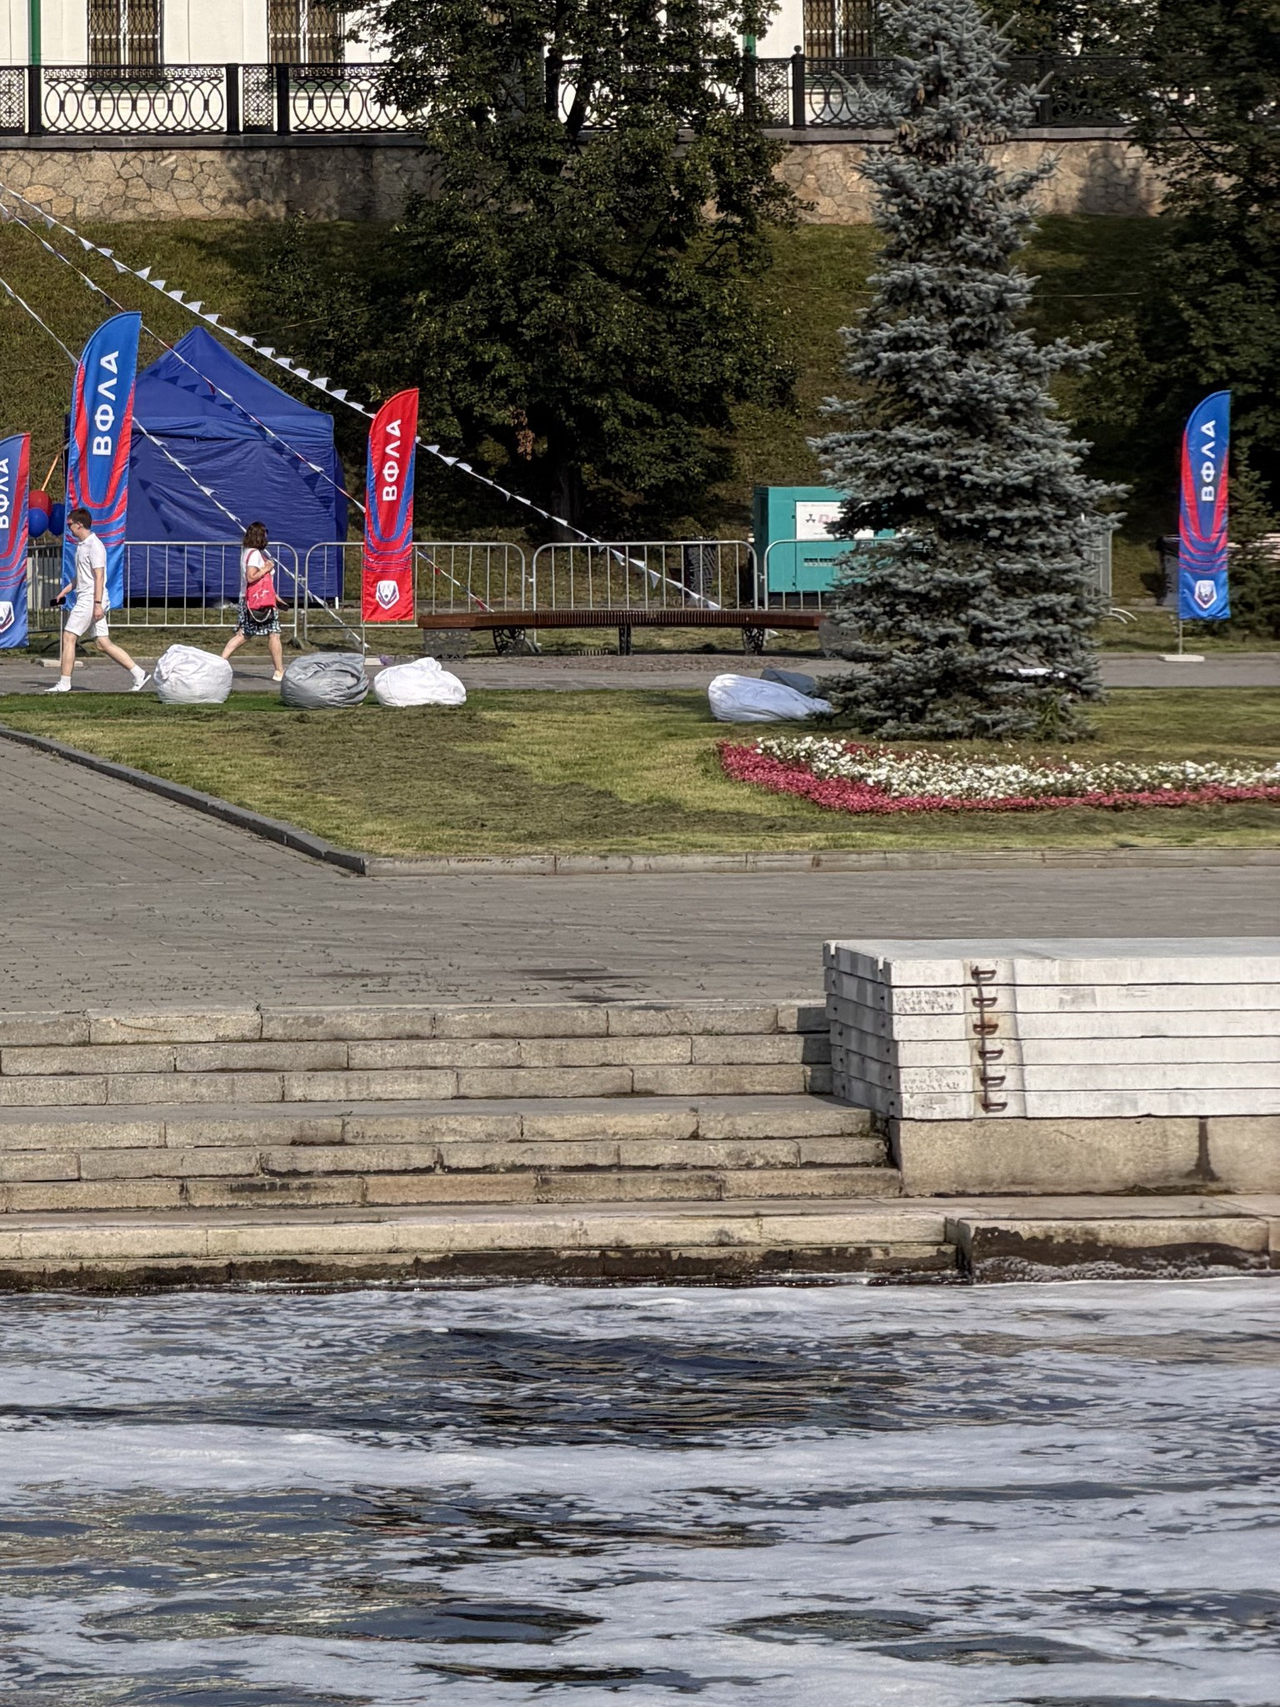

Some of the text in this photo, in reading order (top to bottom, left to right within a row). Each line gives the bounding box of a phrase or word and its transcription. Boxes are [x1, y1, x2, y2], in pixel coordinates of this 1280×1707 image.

[92, 350, 119, 456] ВФЛА
[382, 419, 402, 502] ВФЛА
[1201, 420, 1216, 502] ВФЛА
